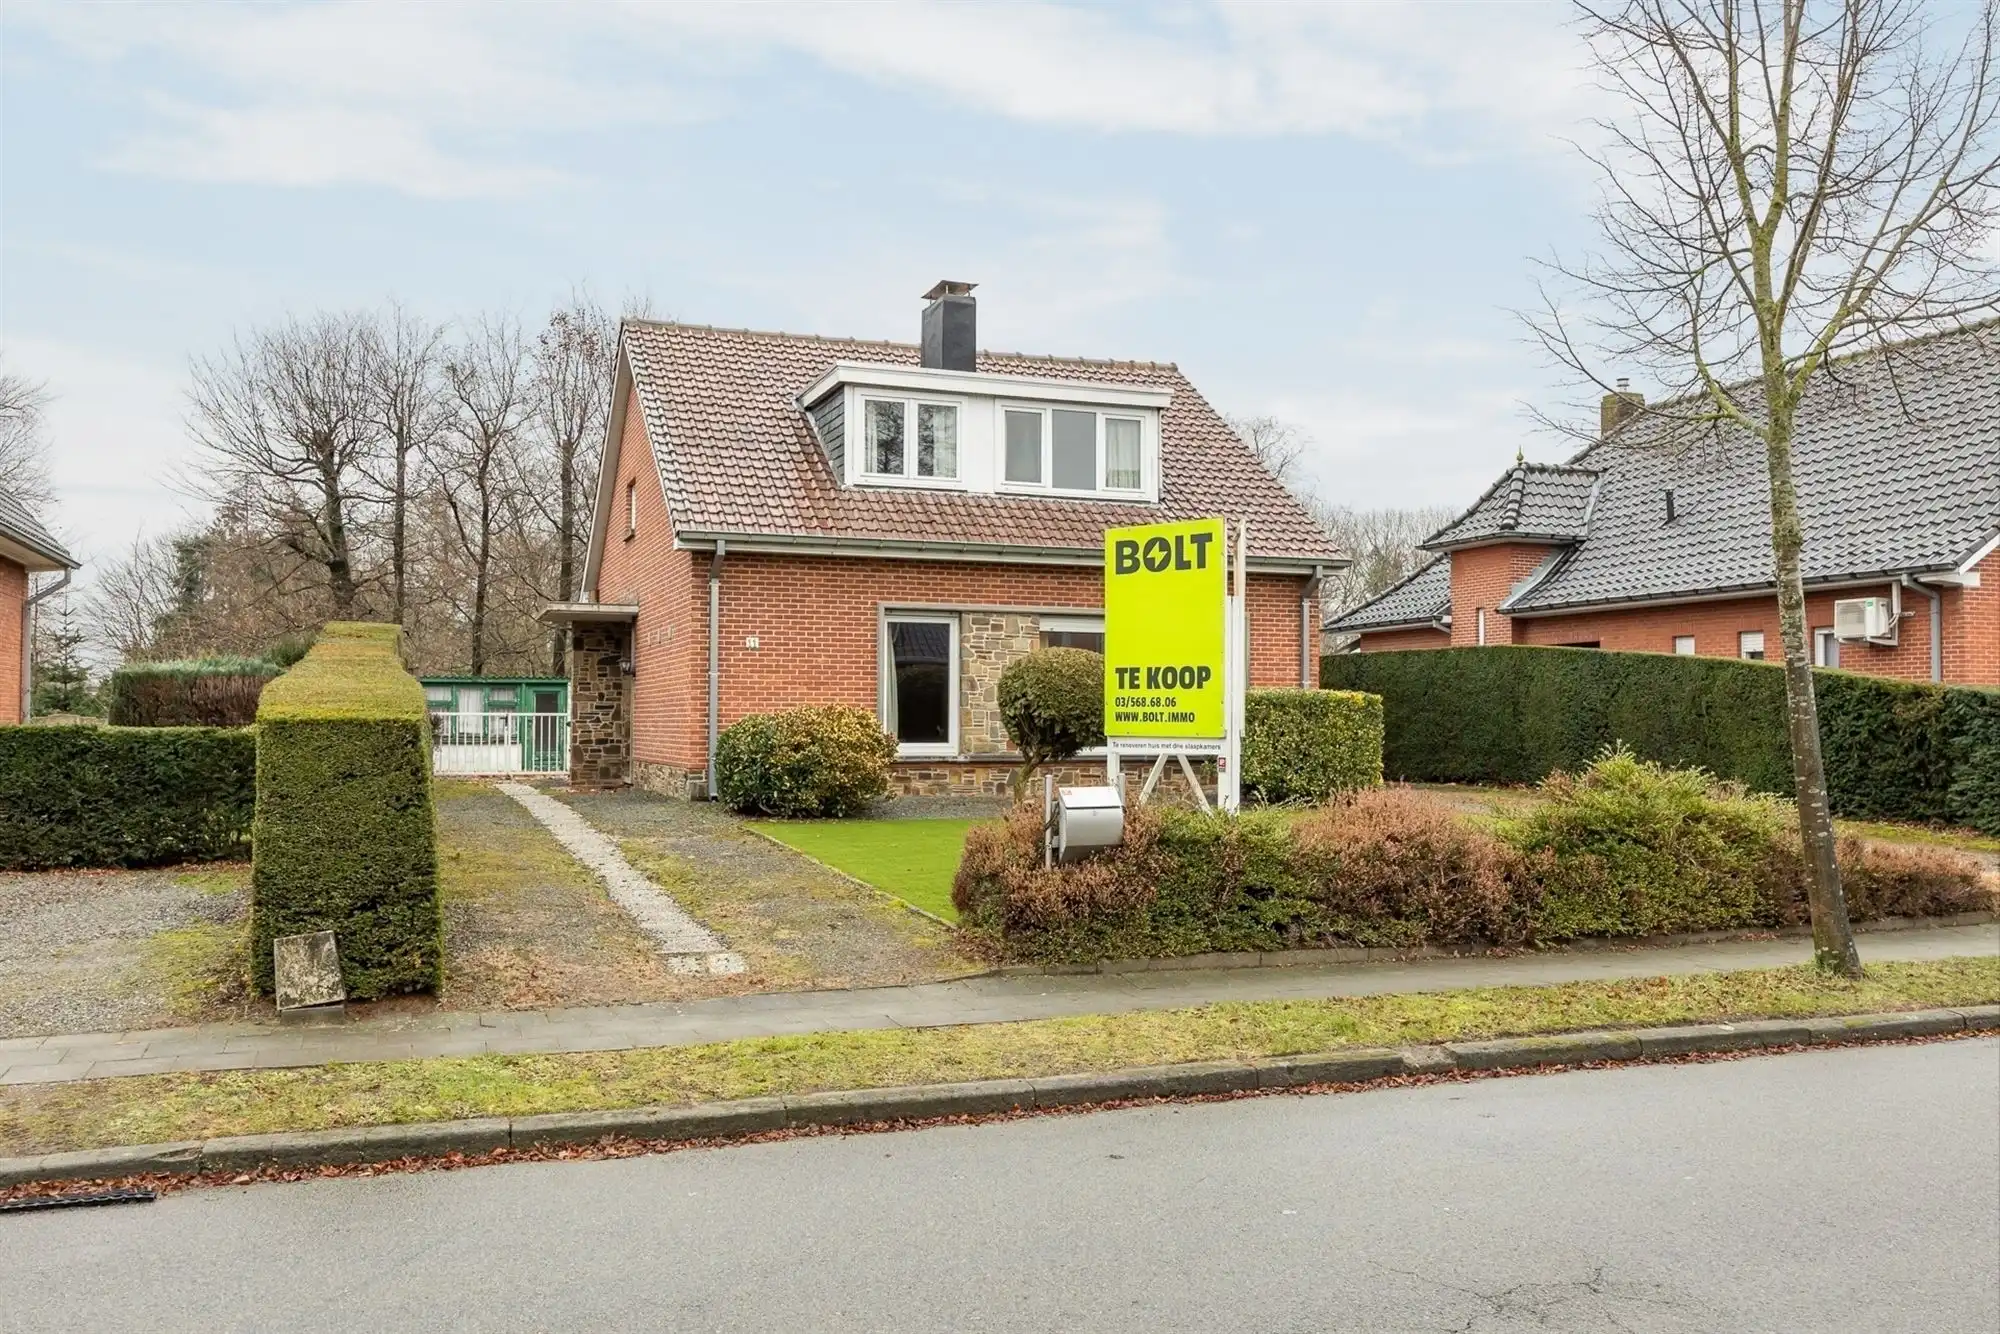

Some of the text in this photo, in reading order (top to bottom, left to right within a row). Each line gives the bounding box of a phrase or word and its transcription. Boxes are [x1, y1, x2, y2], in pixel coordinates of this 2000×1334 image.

[1115, 532, 1213, 575] BOLT
[1115, 665, 1211, 690] TE KOOP
[1114, 696, 1177, 708] 03/568.68.06
[1114, 711, 1196, 723] WWW.BOLT.IMMO
[1185, 742, 1221, 751] slaapkamers
